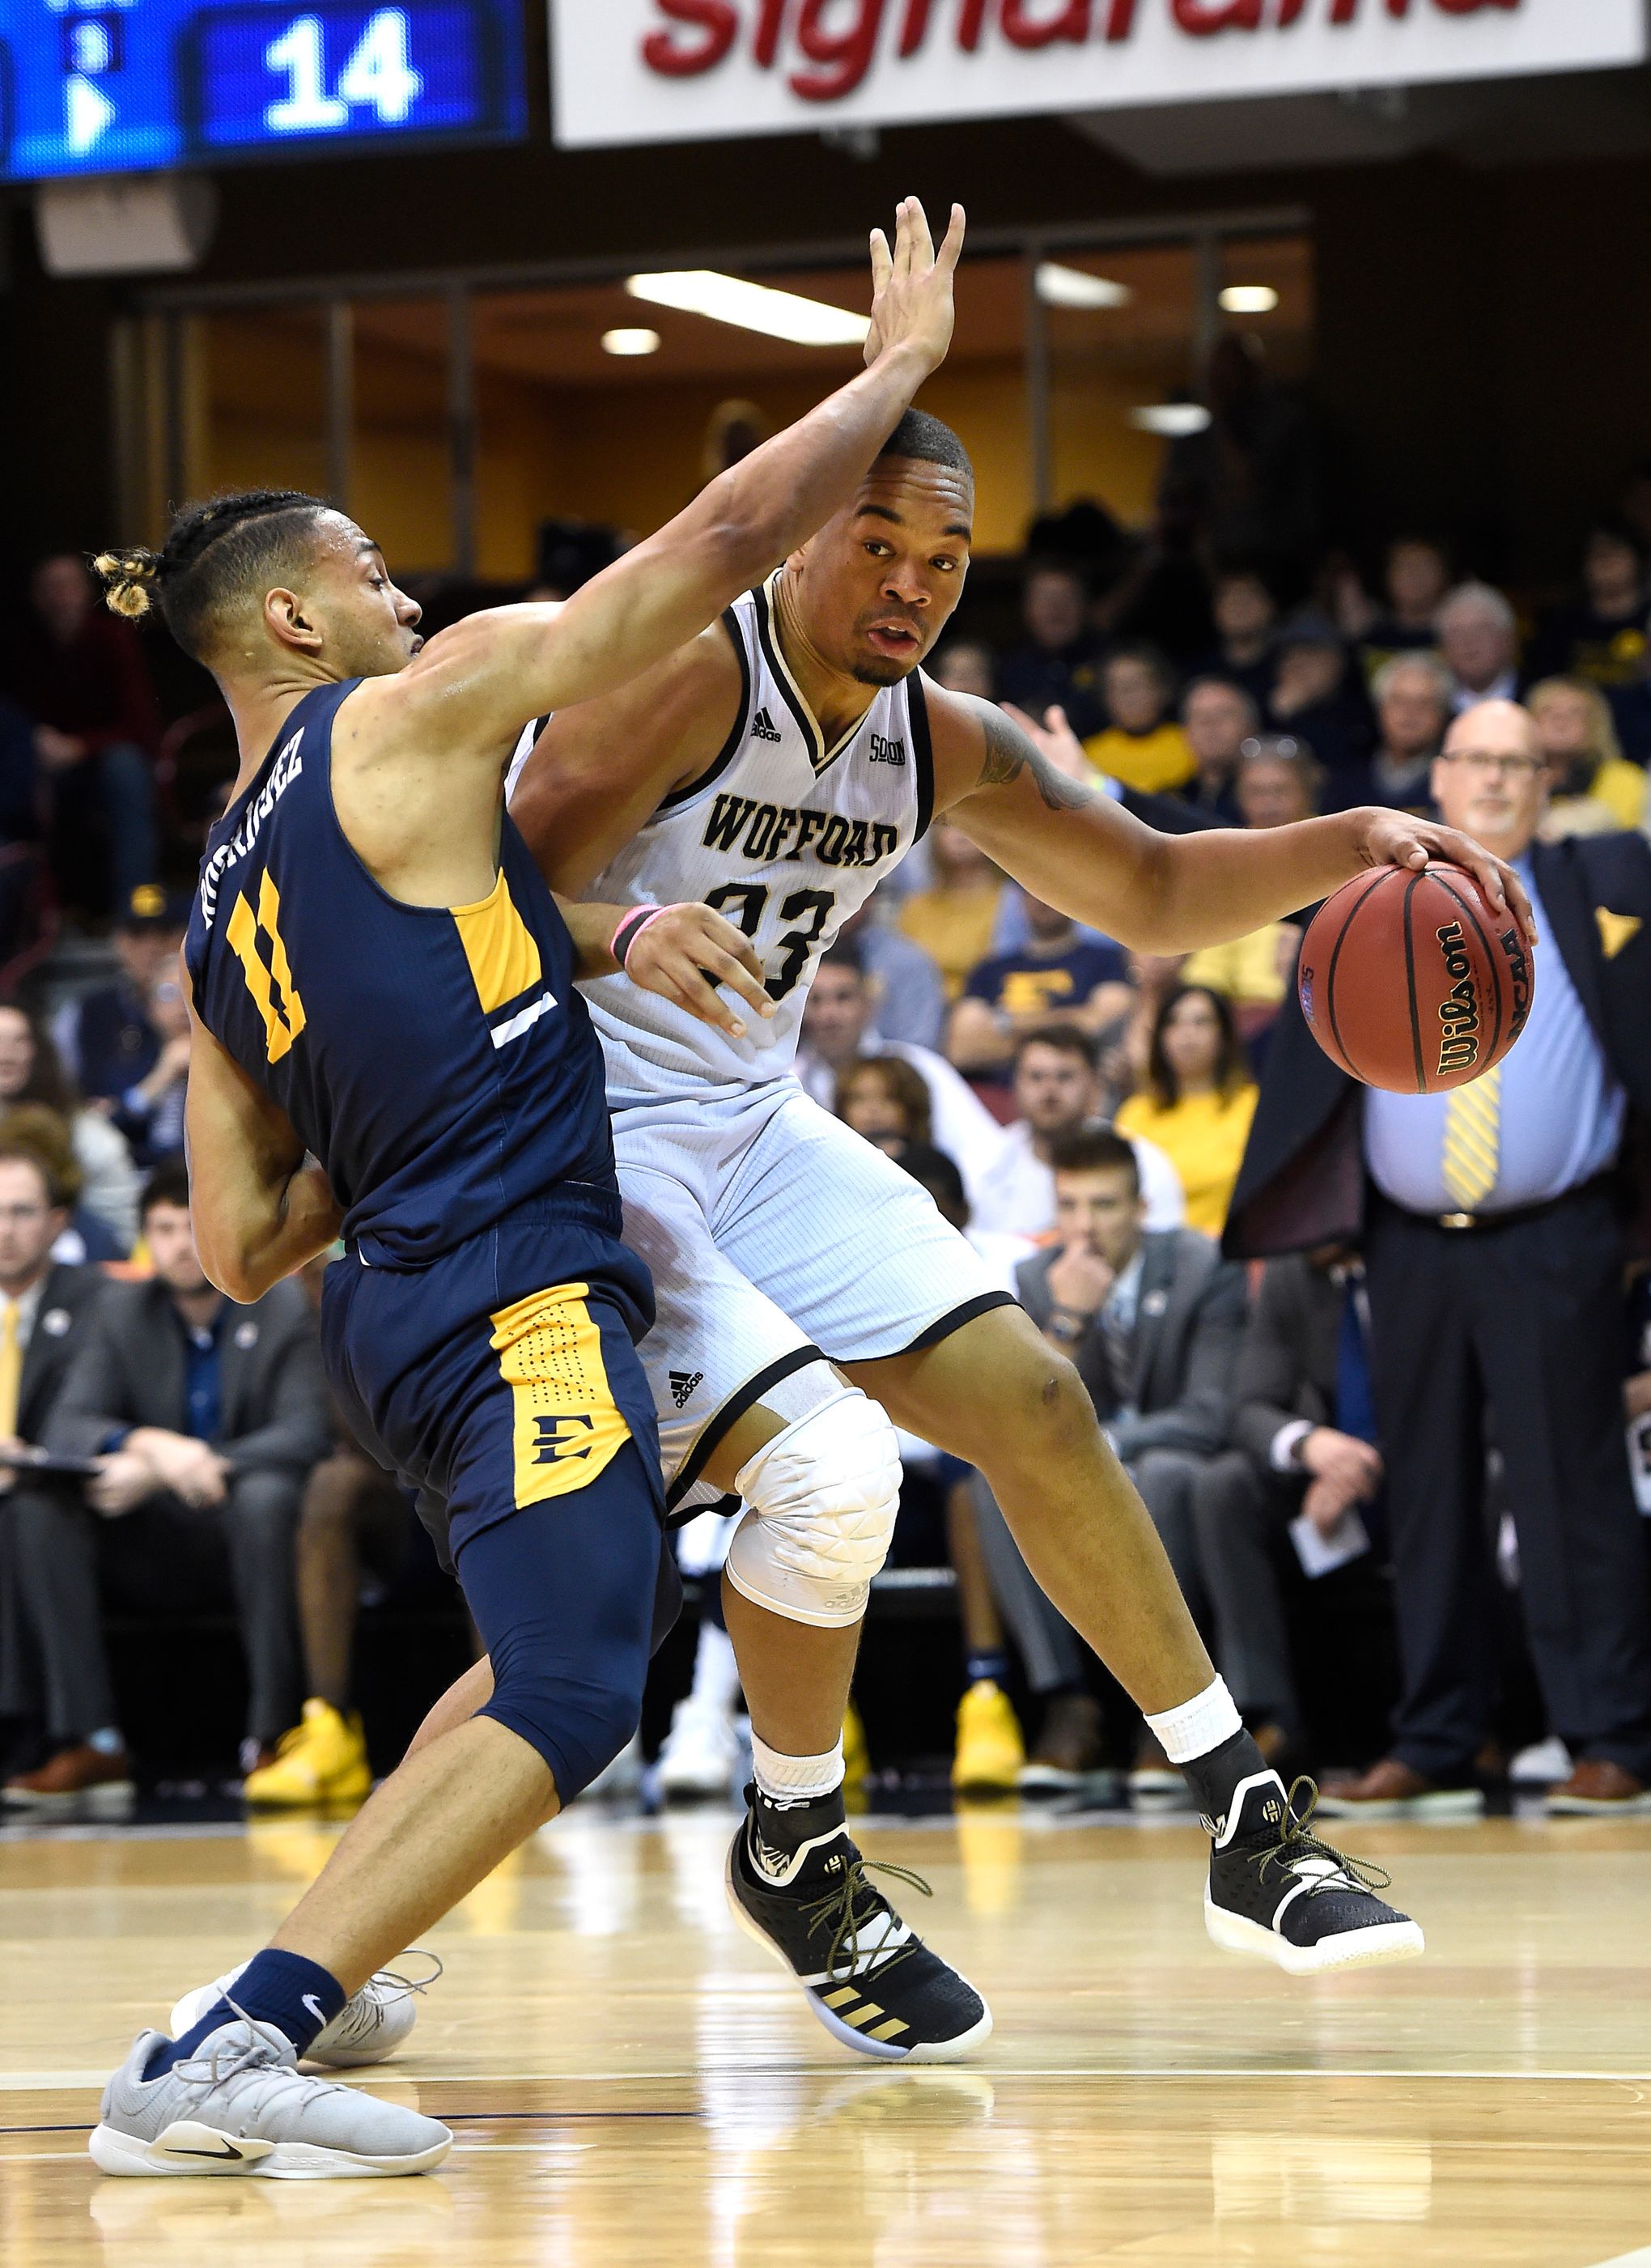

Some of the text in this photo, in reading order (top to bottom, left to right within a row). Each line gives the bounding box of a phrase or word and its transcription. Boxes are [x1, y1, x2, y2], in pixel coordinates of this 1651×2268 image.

[265, 7, 424, 131] 14
[643, 0, 1522, 102] Signa
[701, 792, 900, 869] WOFFORD
[225, 864, 308, 1064] 11
[1436, 920, 1480, 1076] Wilson
[1500, 928, 1529, 1042] NCAA
[531, 1414, 595, 1465] E
[675, 1371, 704, 1409] adidas
